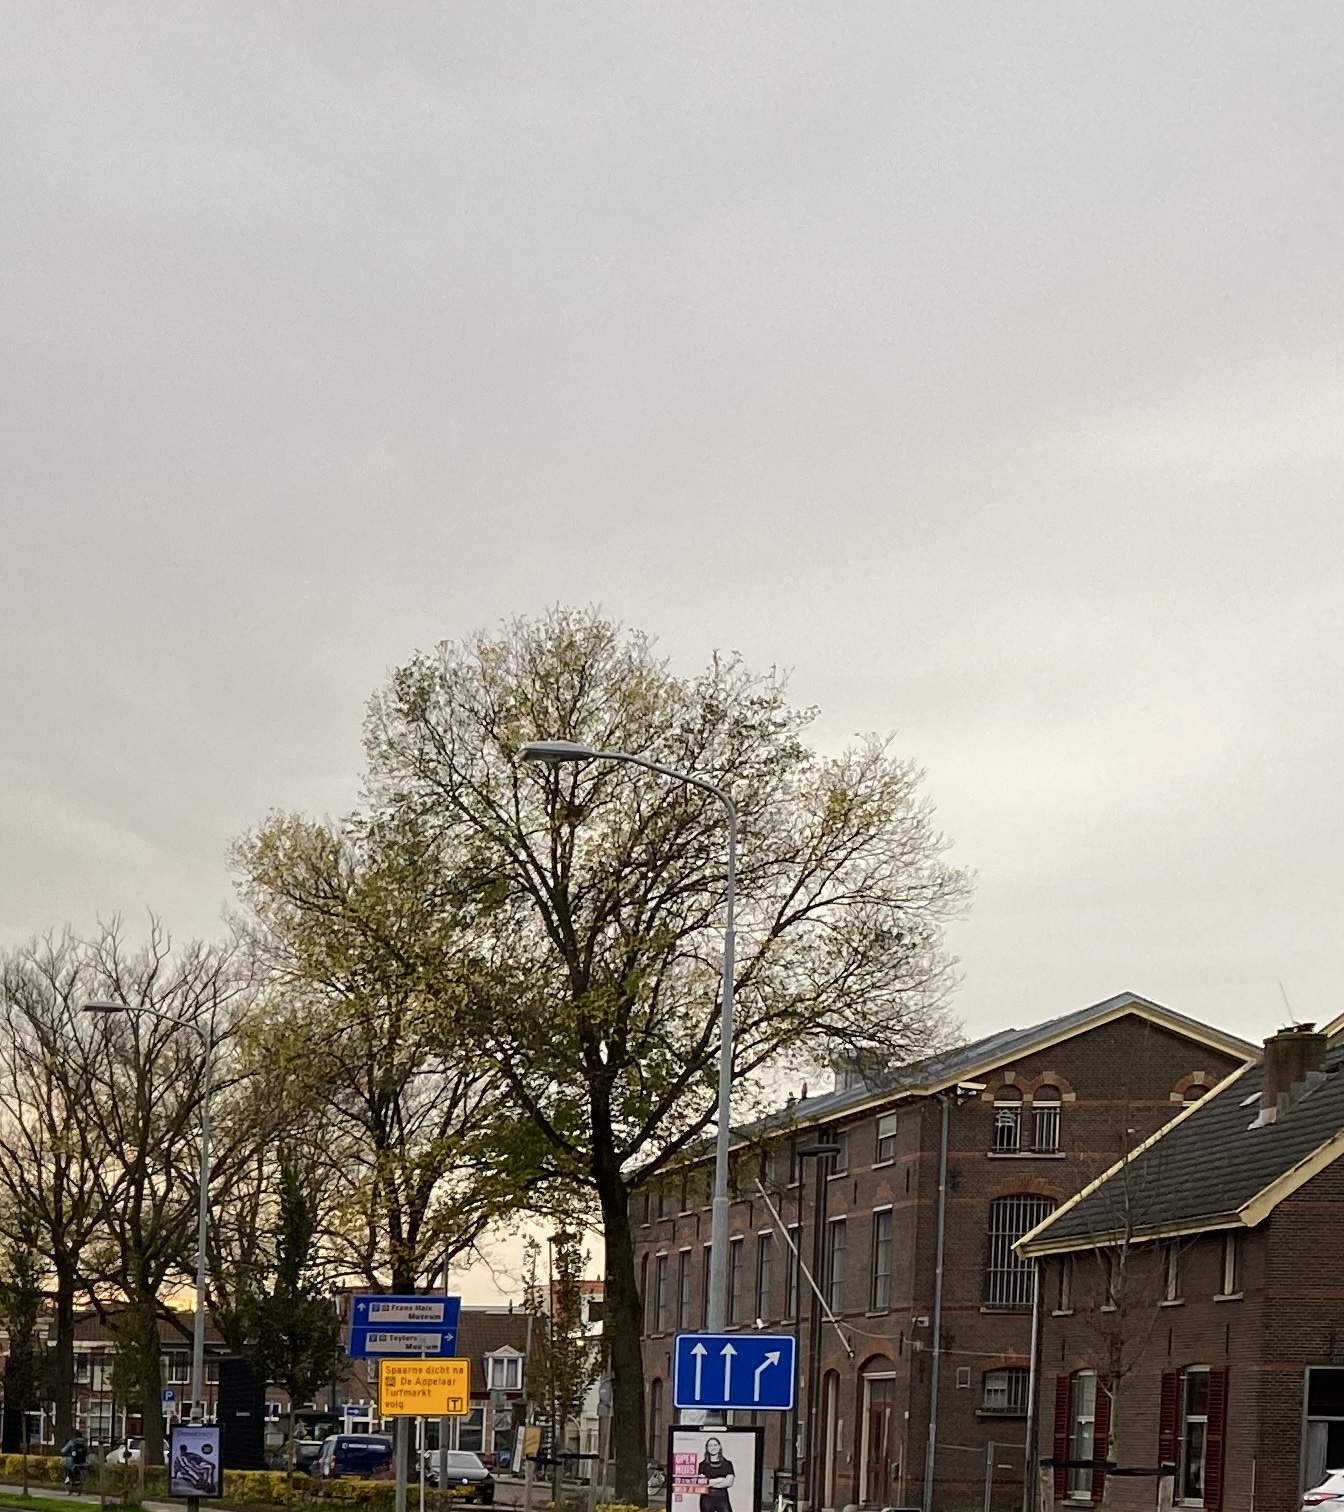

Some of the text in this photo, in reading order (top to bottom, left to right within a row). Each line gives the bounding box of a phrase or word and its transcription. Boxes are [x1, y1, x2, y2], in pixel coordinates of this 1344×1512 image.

[391, 1304, 433, 1312] Frans Hals
[389, 1334, 418, 1343] Teylers
[405, 1343, 439, 1351] Musum
[385, 1365, 464, 1375] Spaarne dicht na
[400, 1377, 457, 1387] De Appelaar
[165, 1391, 173, 1401] P
[385, 1388, 432, 1398] Turfmarkt
[384, 1399, 404, 1409] volg
[451, 1400, 459, 1410] T
[675, 1454, 696, 1464] OPEN
[675, 1465, 695, 1474] HUIS
